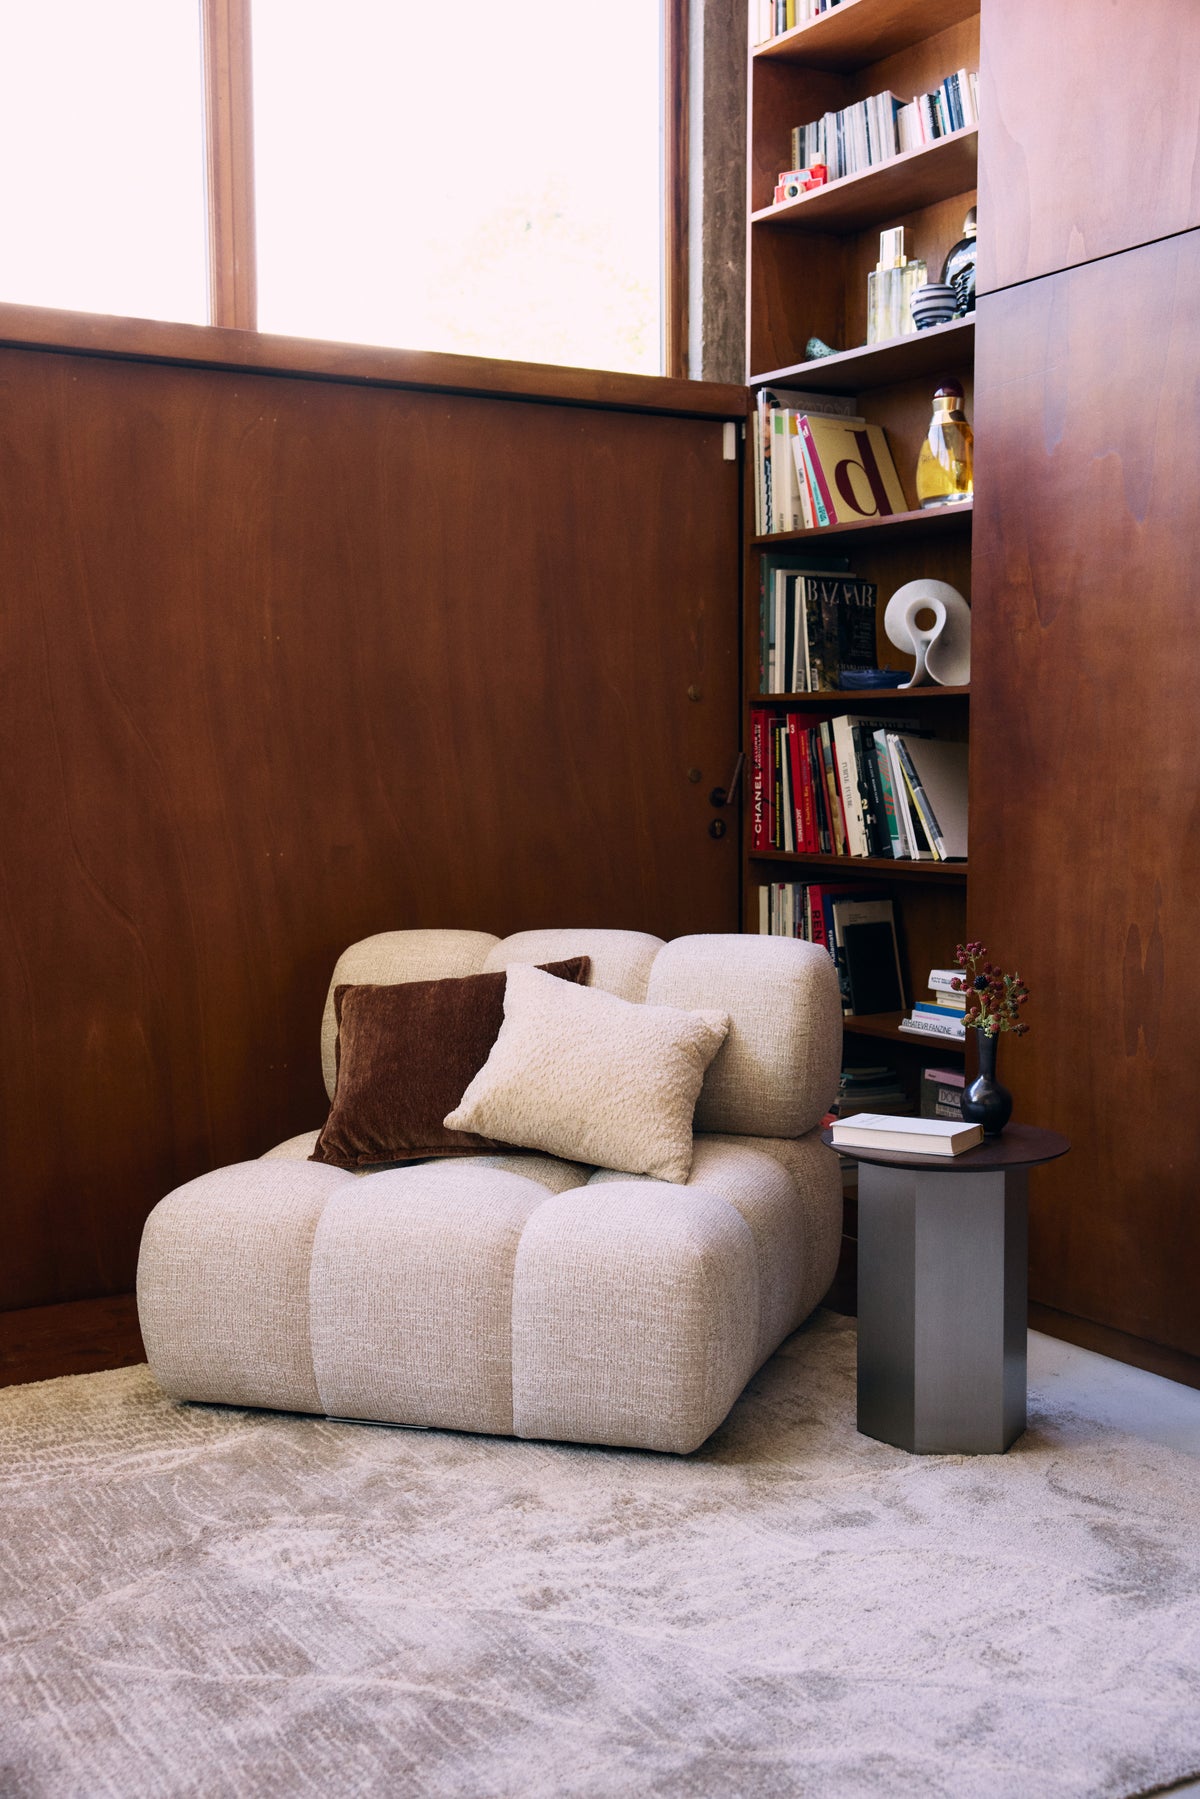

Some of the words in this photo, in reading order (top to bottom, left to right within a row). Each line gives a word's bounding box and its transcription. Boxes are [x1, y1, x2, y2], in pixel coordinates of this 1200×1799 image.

[807, 579, 875, 607] BAZAAR
[754, 767, 762, 834] CHANEL
[795, 808, 803, 842] JACQUEMUS
[811, 910, 823, 941] REN
